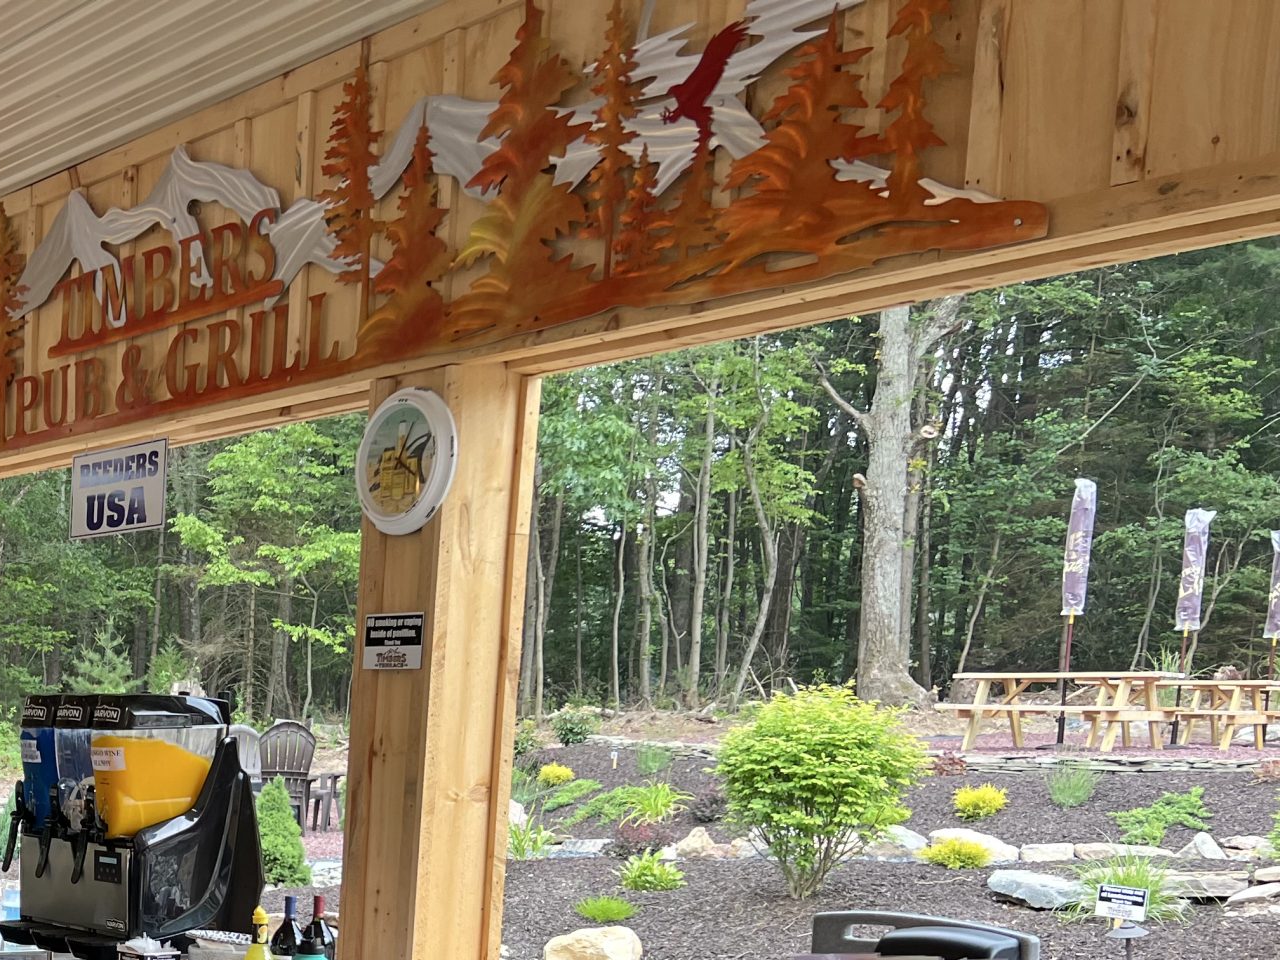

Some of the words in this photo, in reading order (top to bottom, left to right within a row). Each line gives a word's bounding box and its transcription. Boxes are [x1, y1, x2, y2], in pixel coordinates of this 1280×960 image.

[54, 208, 278, 346] TIMBERS
[15, 356, 105, 437] PUB
[116, 344, 153, 408] &
[166, 293, 341, 401] GRILL
[86, 486, 147, 531] USA
